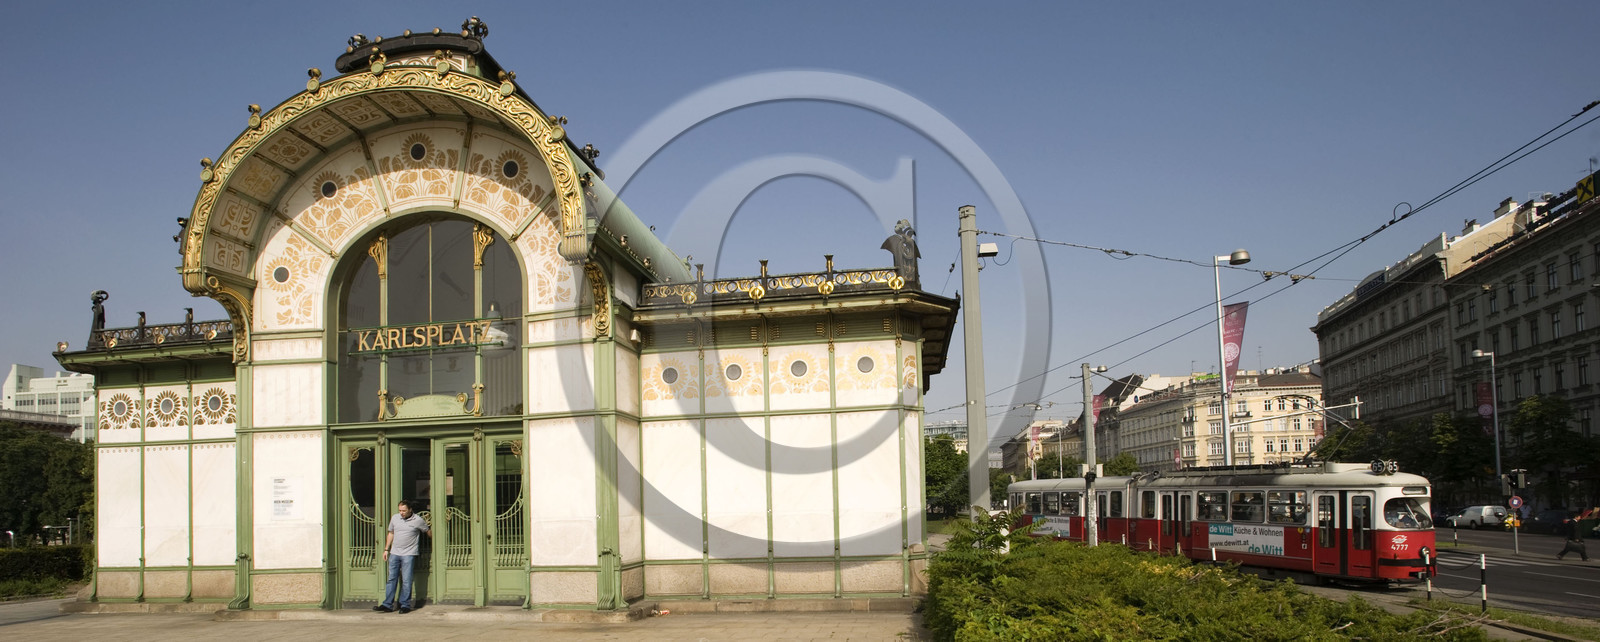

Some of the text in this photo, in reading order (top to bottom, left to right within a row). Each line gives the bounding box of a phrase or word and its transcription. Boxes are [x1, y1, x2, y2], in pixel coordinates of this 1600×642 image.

[358, 320, 493, 352] KARLSPLATZ
[1372, 462, 1383, 472] 65
[1388, 461, 1398, 471] 65
[1209, 525, 1233, 534] de Witt
[1234, 526, 1283, 536] Küche & Wohnen
[1210, 539, 1249, 547] www.dewitt.at
[1248, 544, 1283, 555] de Witt
